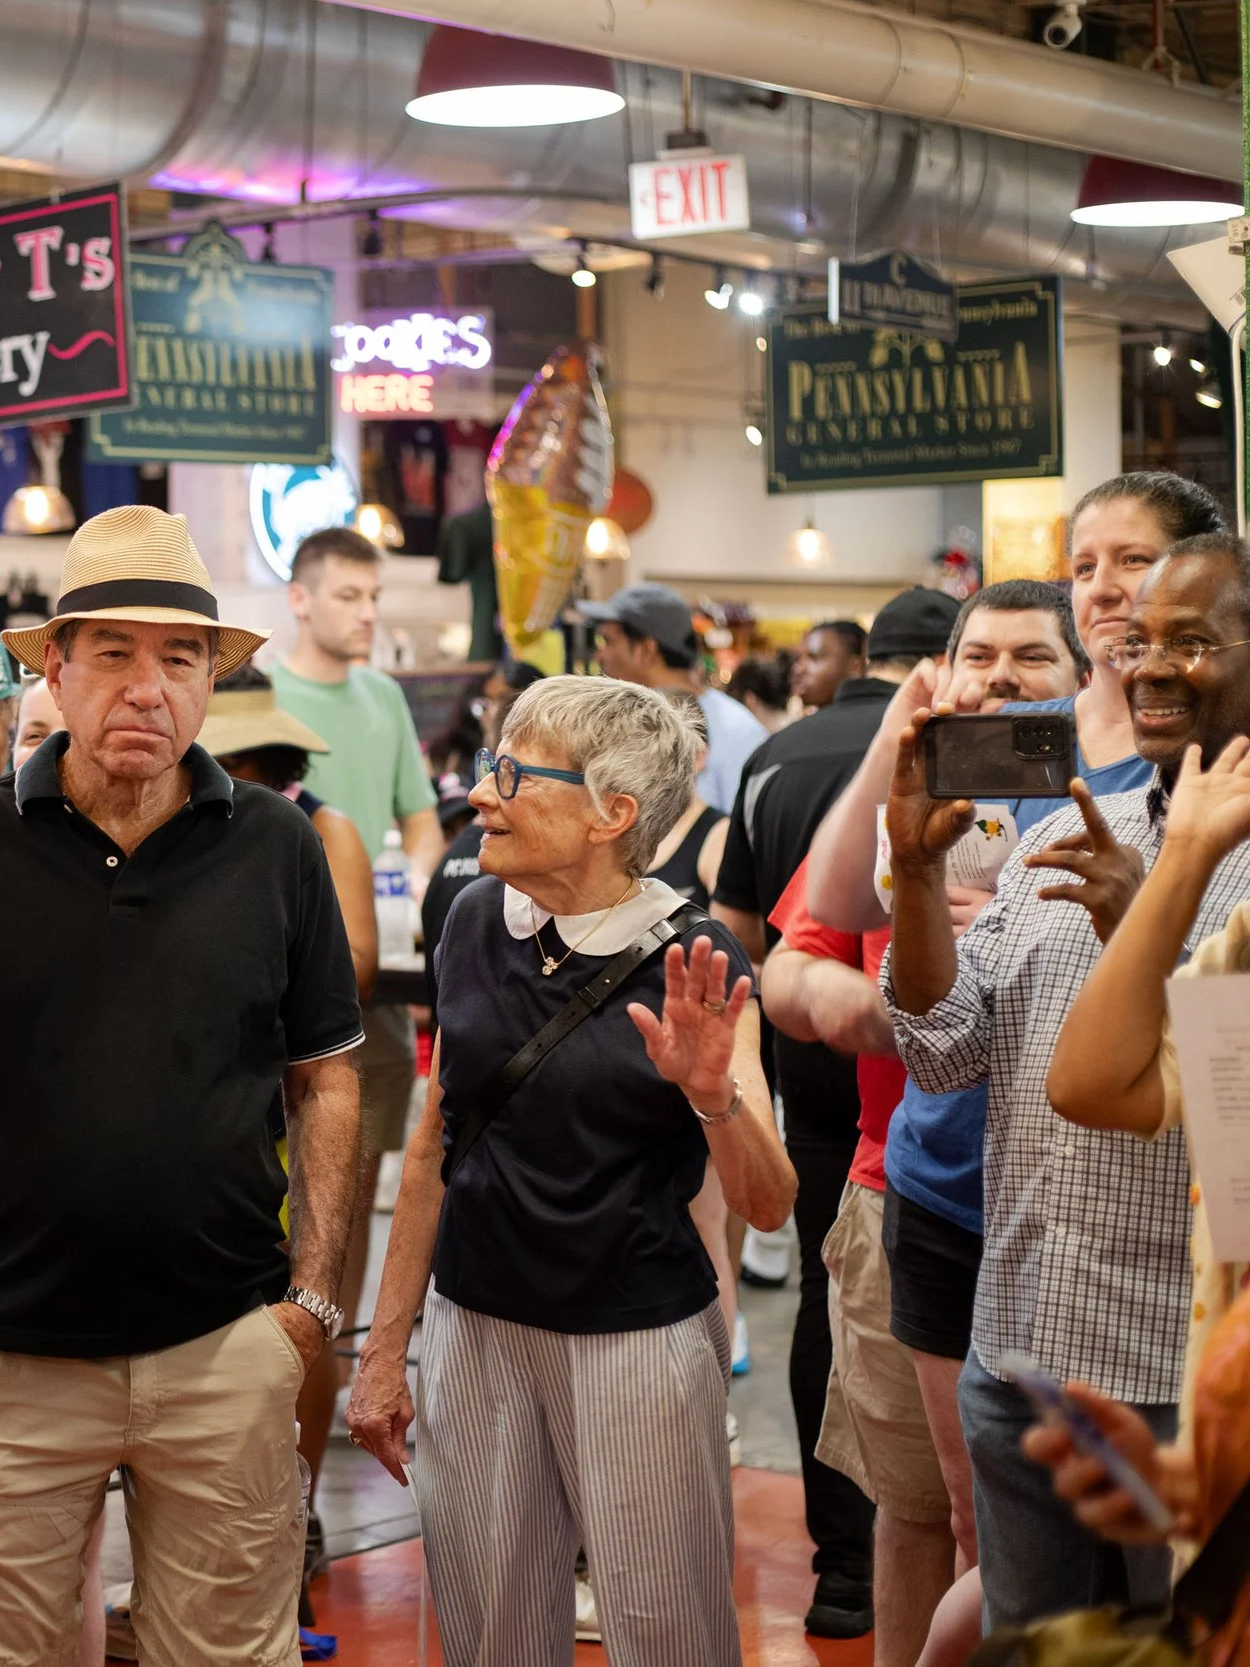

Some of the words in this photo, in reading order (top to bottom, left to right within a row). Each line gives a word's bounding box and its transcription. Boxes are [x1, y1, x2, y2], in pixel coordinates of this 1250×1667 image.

[654, 160, 730, 225] EXIT
[338, 373, 435, 414] HERE
[787, 340, 1033, 424] PENNSYLVANIA
